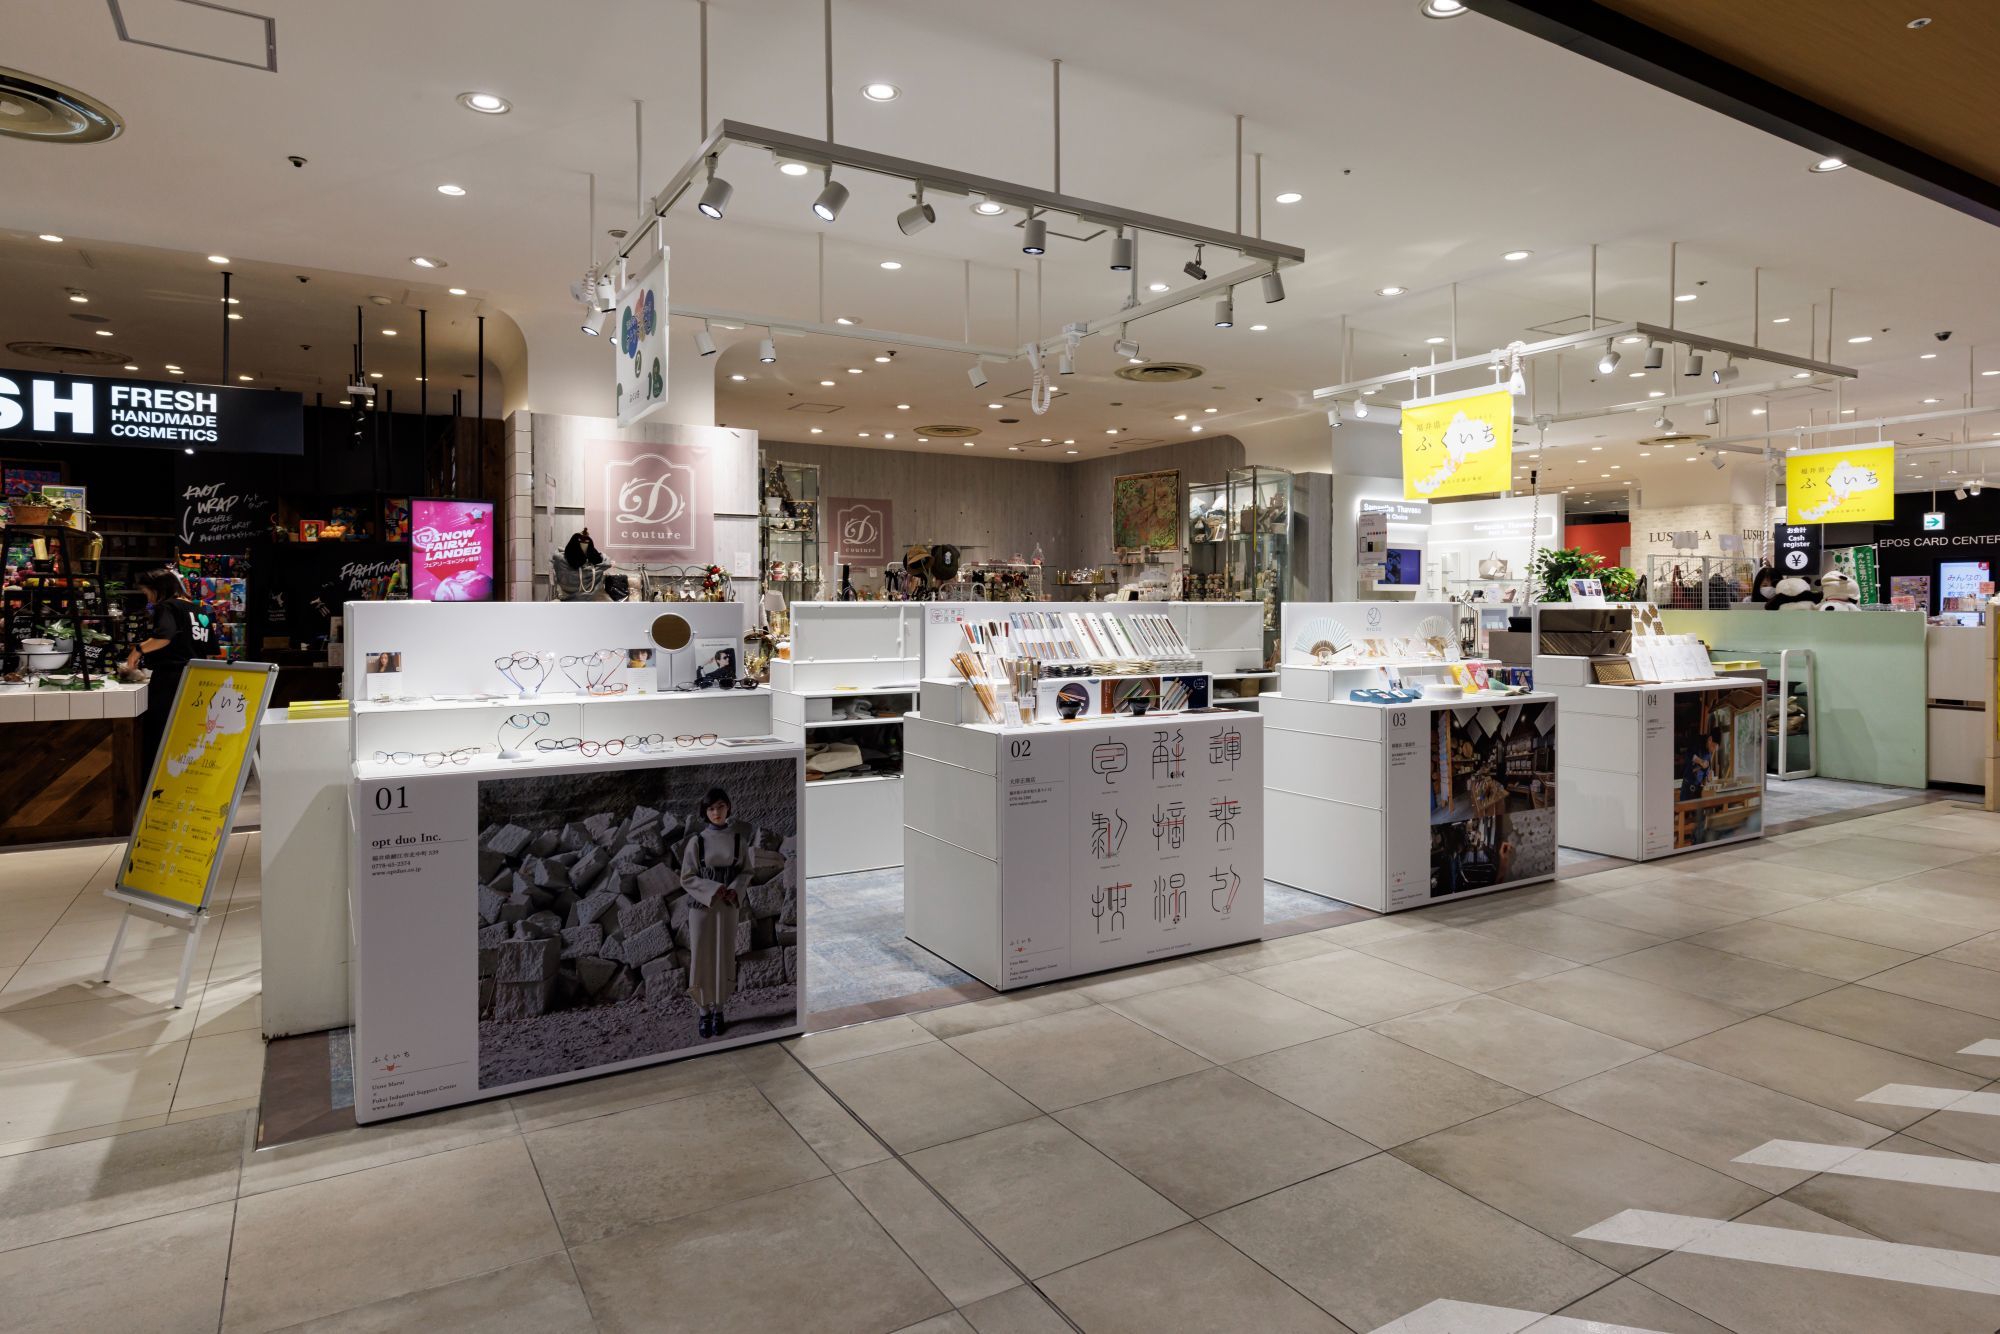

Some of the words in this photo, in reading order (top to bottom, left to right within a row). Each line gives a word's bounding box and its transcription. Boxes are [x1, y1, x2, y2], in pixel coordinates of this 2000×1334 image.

[111, 386, 217, 413] FRESH
[111, 409, 217, 428] HANDMADE
[111, 424, 218, 442] COSMETICS
[1415, 426, 1496, 452] ふくいち
[1800, 471, 1878, 489] ふくいち
[182, 483, 225, 500] KNOT
[197, 496, 239, 513] WRAP
[431, 528, 476, 543] SNOW
[620, 529, 681, 540] couture
[1786, 526, 1808, 534] お会計
[425, 539, 468, 553] FAIRY
[1880, 539, 1910, 548] EPOS
[1913, 537, 1949, 547] CARD
[425, 546, 482, 562] LANDED
[339, 558, 400, 580] FIGHTING
[191, 691, 247, 713] ふくいち
[1647, 694, 1657, 706] 04
[1393, 712, 1406, 727] 03
[1011, 740, 1031, 758] 02
[375, 786, 409, 811] 01
[372, 839, 391, 849] opt
[395, 835, 416, 846] duo
[421, 833, 442, 843] Inc.
[416, 1087, 438, 1096] Support
